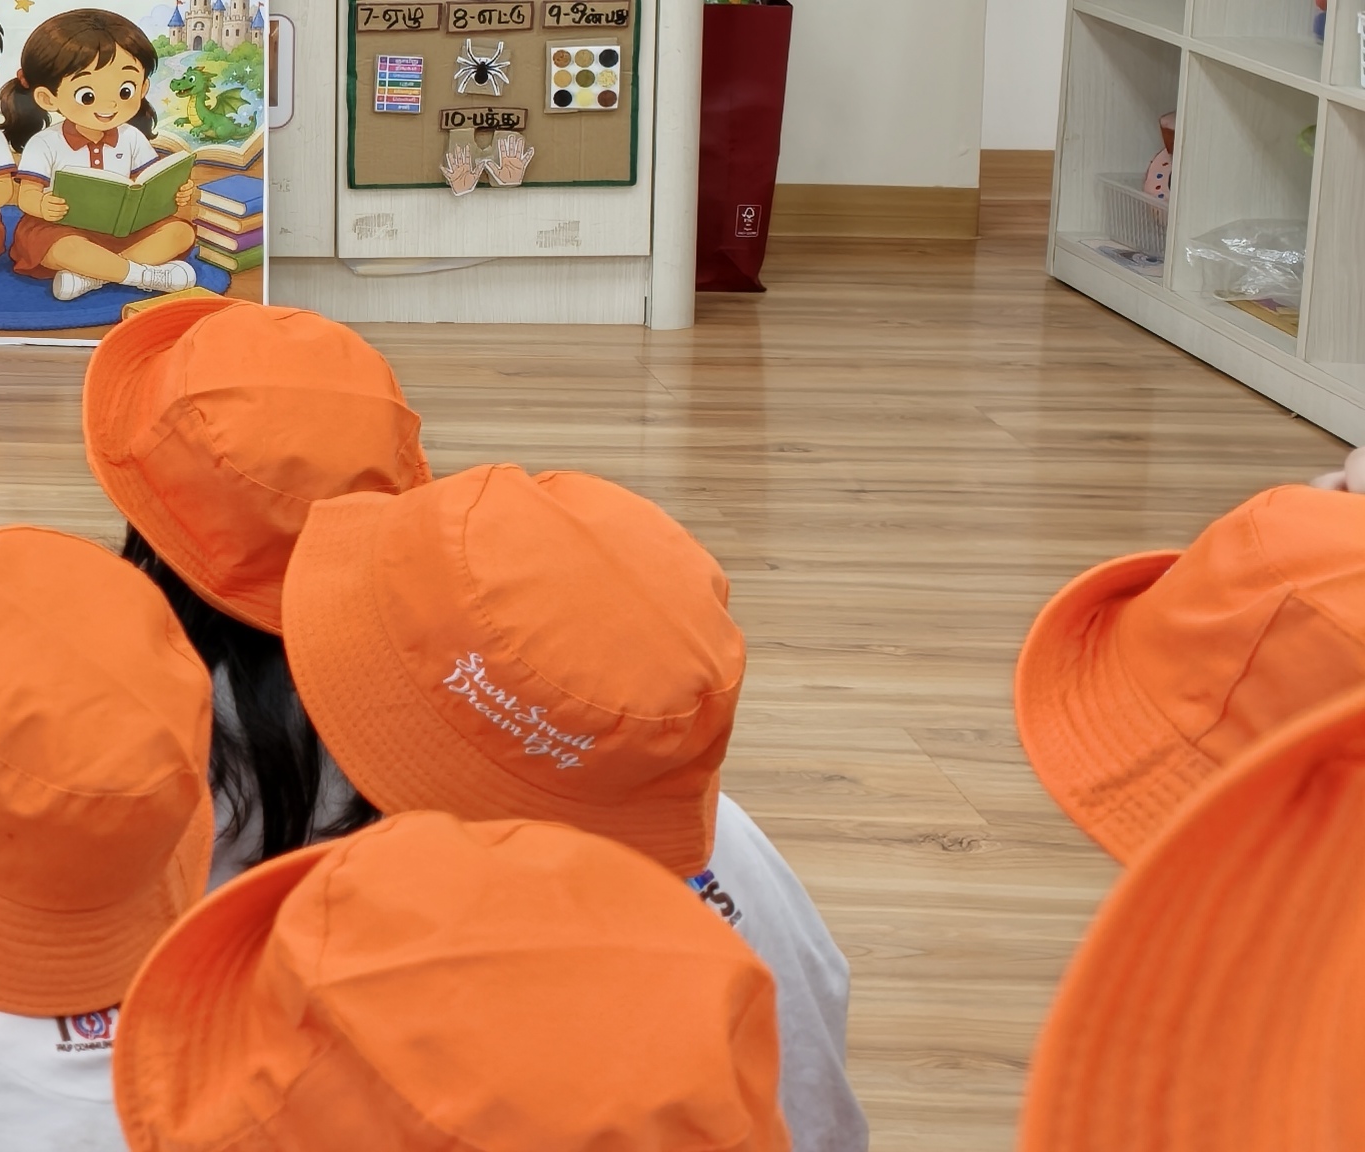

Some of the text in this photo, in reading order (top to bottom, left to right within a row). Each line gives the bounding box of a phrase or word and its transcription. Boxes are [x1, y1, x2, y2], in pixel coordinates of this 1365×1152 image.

[442, 668, 585, 770] Dream Big
[456, 651, 596, 750] Start Small
